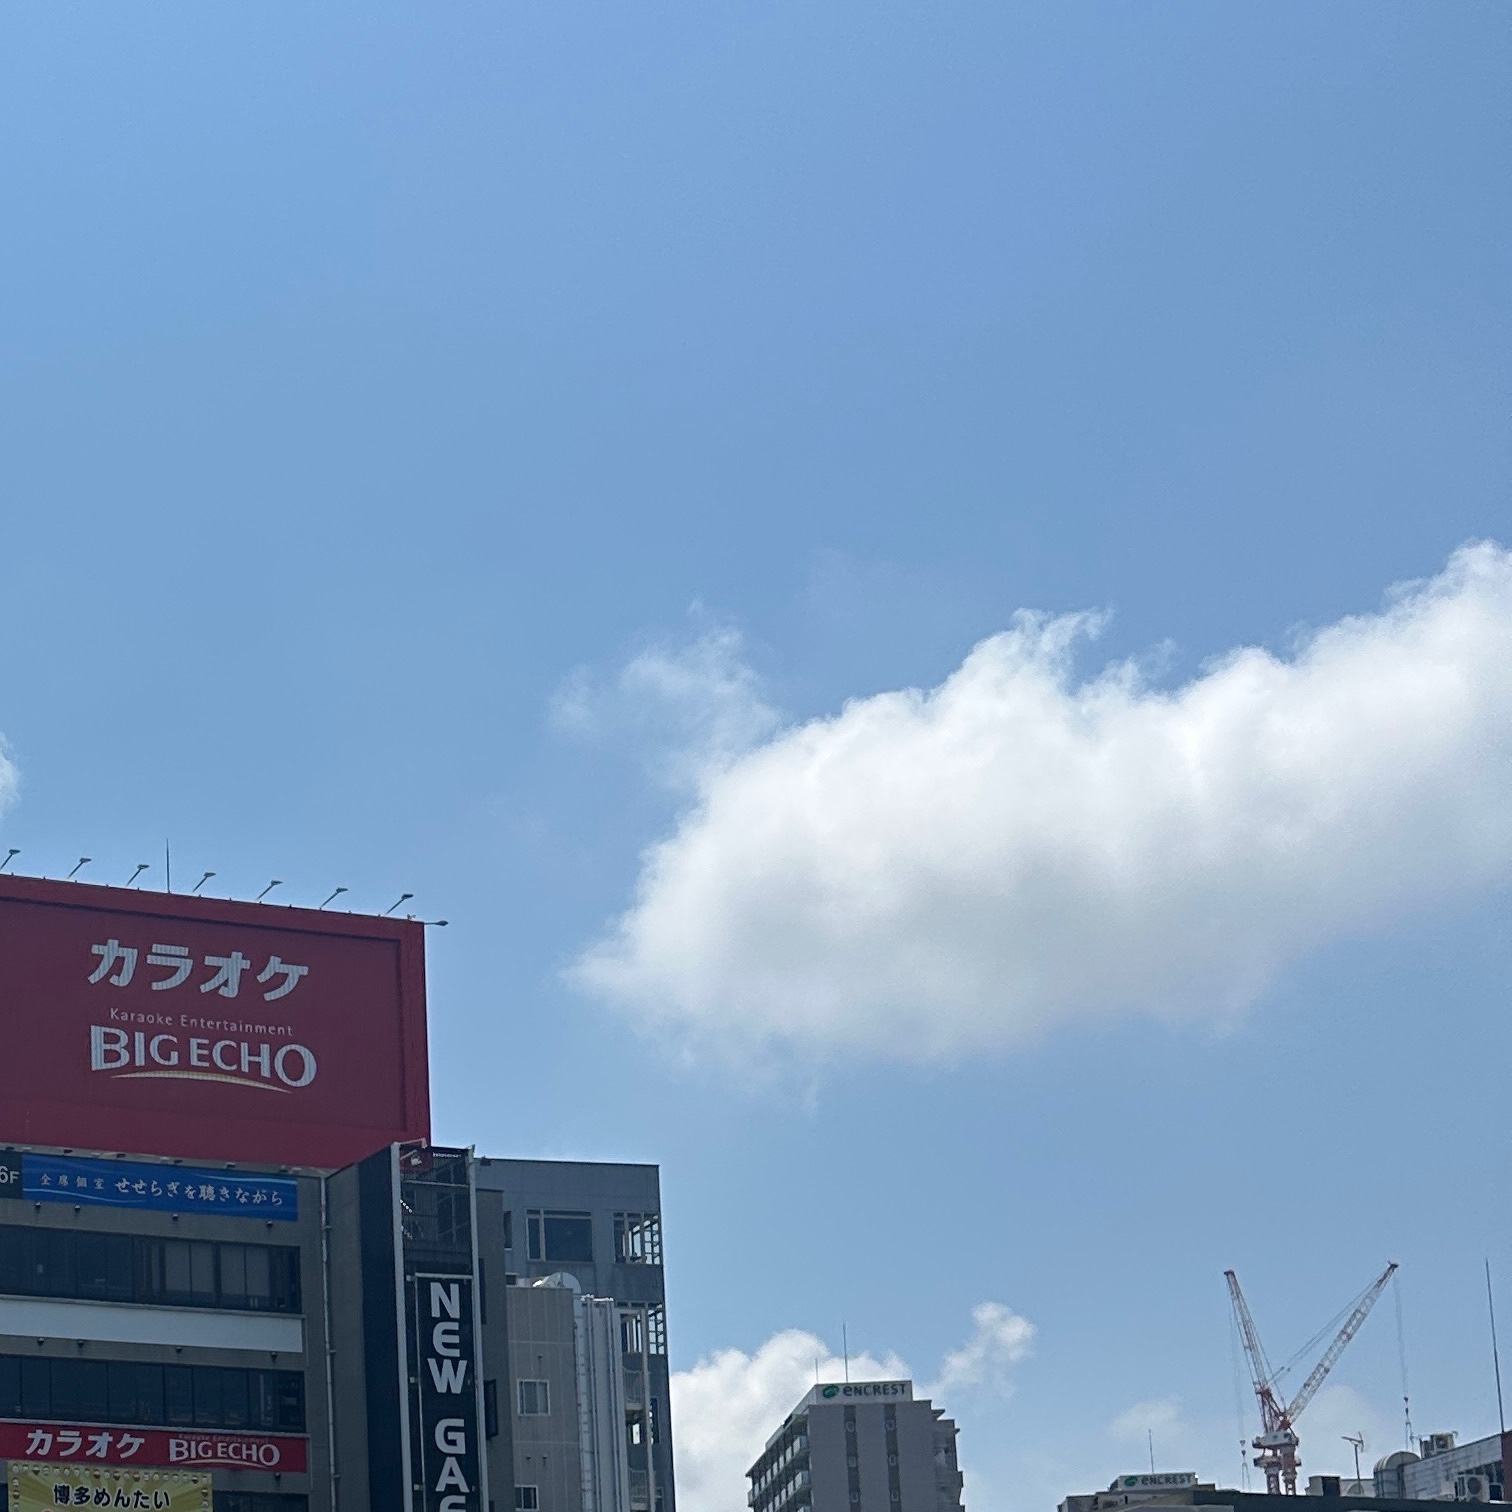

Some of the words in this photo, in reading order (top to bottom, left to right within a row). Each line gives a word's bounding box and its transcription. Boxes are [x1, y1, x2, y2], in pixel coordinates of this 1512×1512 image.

[88, 939, 309, 1001] カラオケ
[110, 1008, 173, 1026] Karaoke
[180, 1014, 294, 1036] Entertainment
[91, 1025, 180, 1071] BIG
[190, 1038, 317, 1087] ECHO
[115, 1178, 284, 1206] せせらぎを聴きながら
[427, 1282, 467, 1394] NEW
[25, 1428, 145, 1459] カラオケ
[169, 1438, 213, 1462] BIG
[219, 1444, 281, 1466] ECHO
[54, 1484, 171, 1509] 博多めんたい
